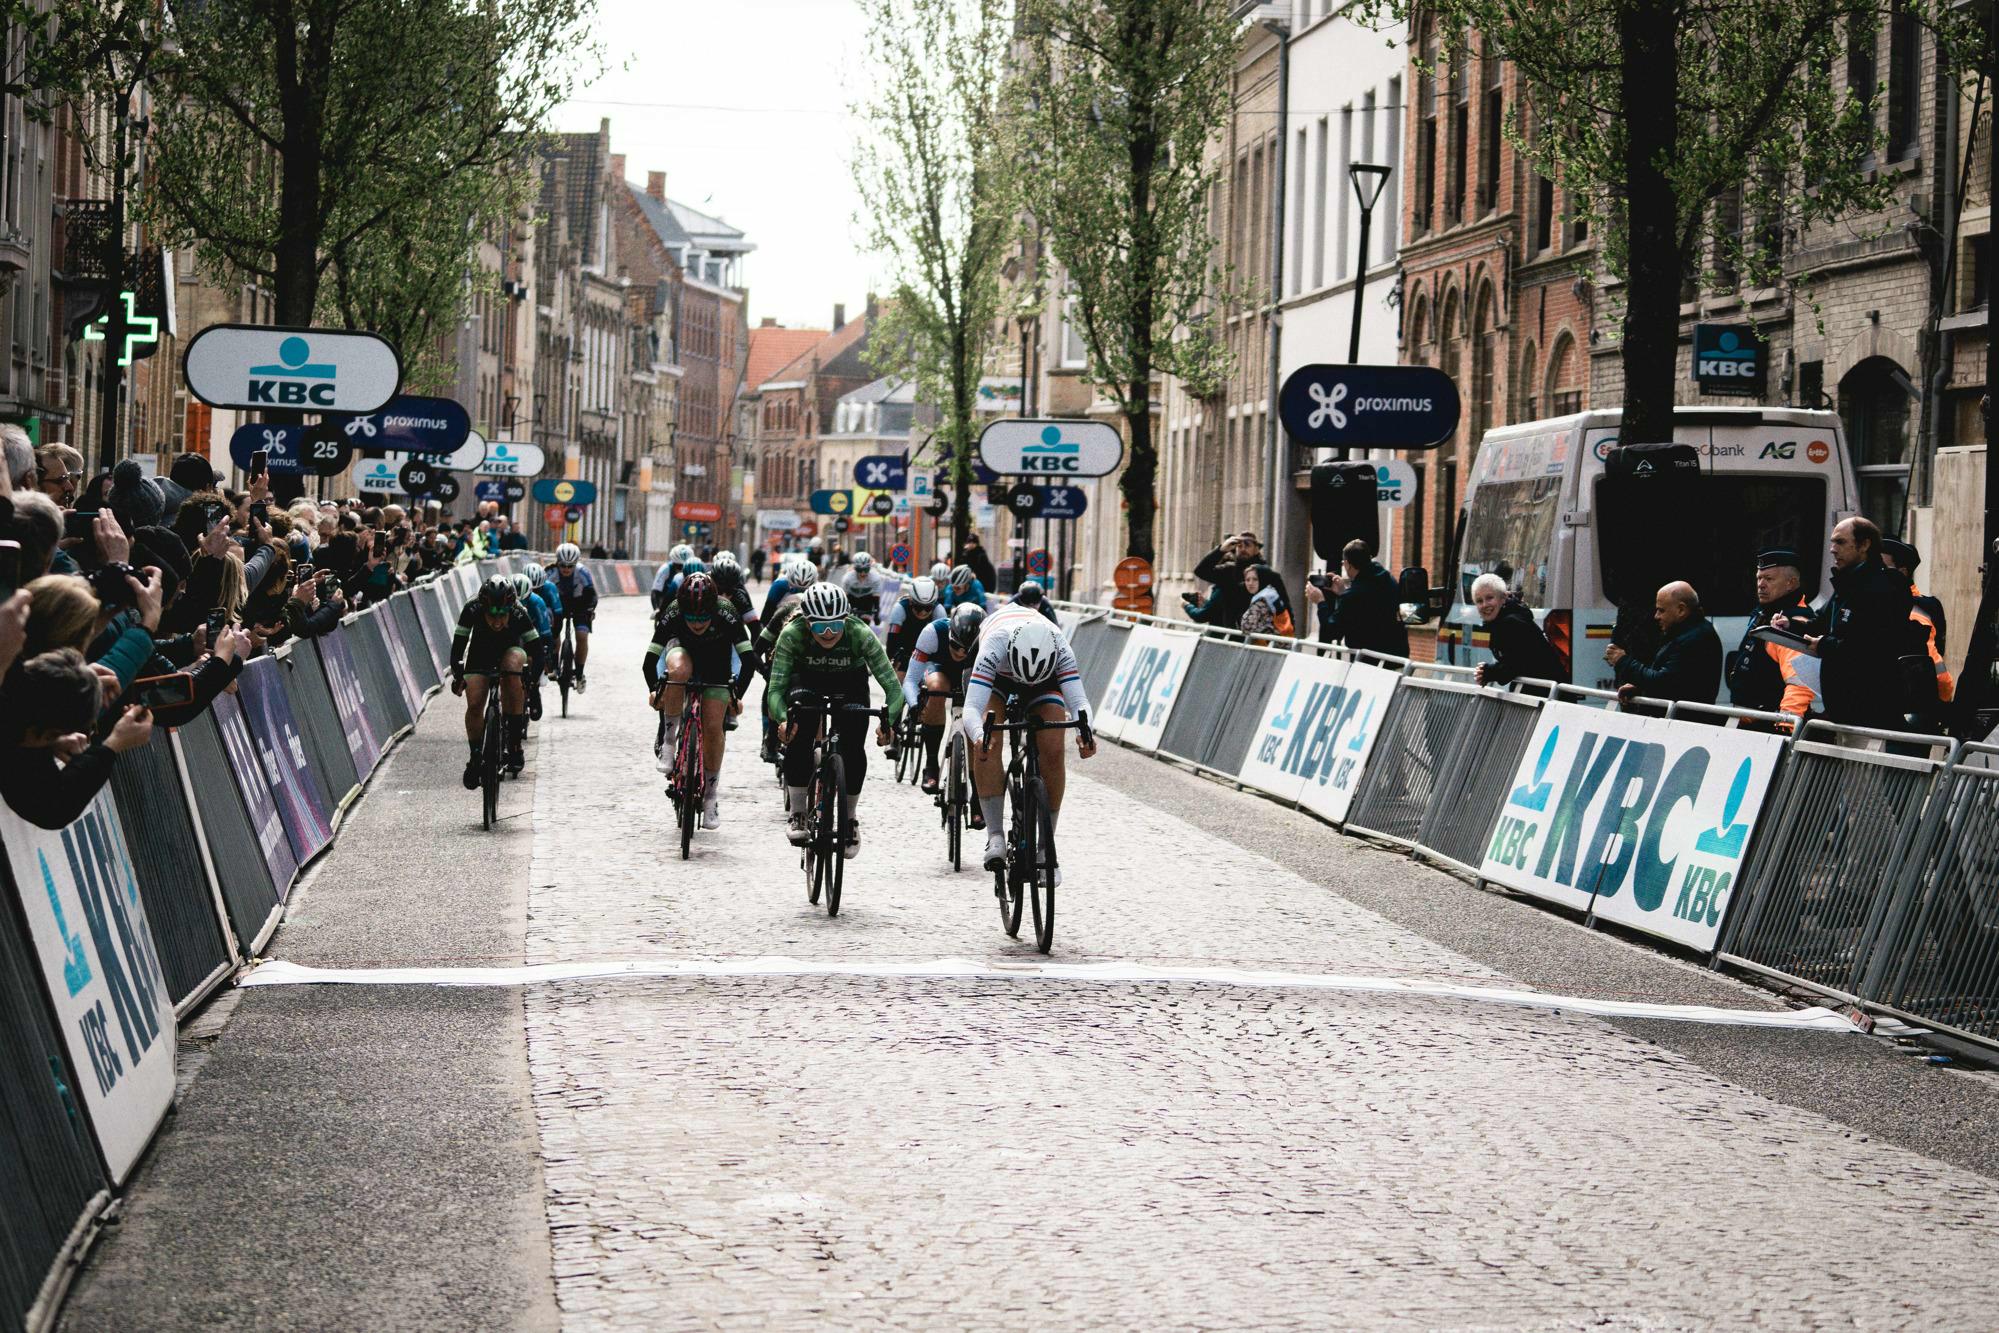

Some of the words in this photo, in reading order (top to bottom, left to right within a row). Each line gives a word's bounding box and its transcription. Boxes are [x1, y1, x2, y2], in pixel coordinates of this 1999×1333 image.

[1699, 360, 1755, 377] KBC
[248, 380, 336, 405] KBC
[1354, 397, 1432, 414] proximus
[383, 415, 447, 430] proximus
[313, 441, 338, 459] 25
[1759, 441, 1797, 460] AG
[483, 463, 518, 474] KBC
[1021, 456, 1079, 472] KBC
[364, 478, 396, 489] KBC
[409, 471, 426, 484] 50
[440, 484, 453, 495] 75
[1376, 489, 1402, 501] BC
[1016, 494, 1034, 507] 50
[1113, 645, 1172, 726] KBC
[1280, 681, 1363, 787] KBC
[1256, 733, 1284, 765] KBC
[1534, 731, 1711, 912] KBC
[1488, 815, 1535, 870] KBC
[1673, 864, 1733, 928] KBC
[79, 1000, 123, 1098] KBC
